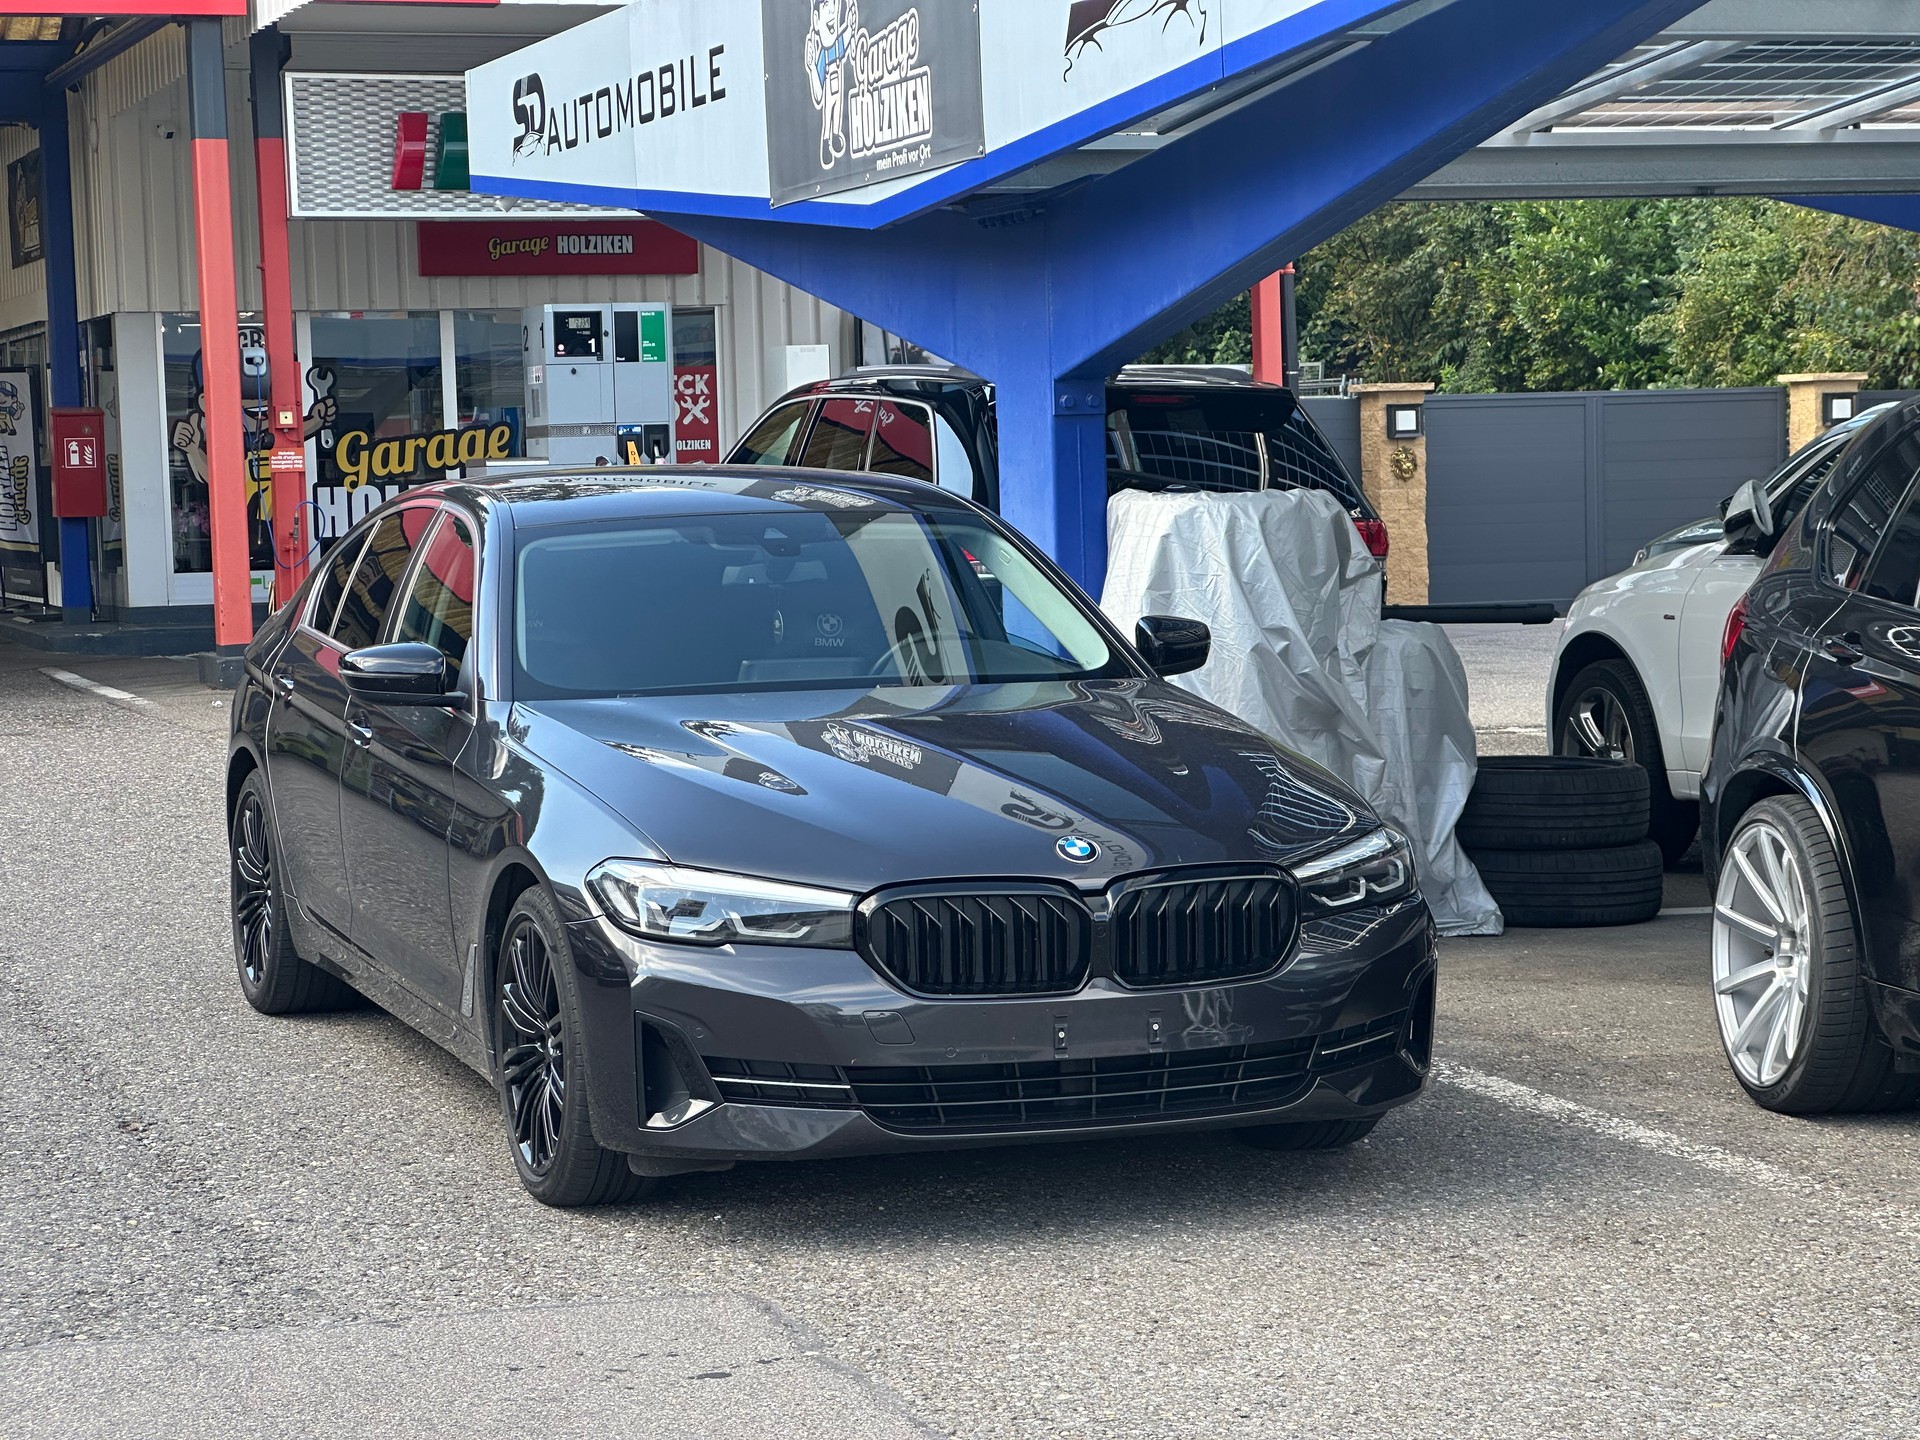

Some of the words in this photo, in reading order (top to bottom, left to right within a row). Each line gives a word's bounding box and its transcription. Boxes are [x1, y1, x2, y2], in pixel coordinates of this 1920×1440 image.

[855, 14, 917, 96] Garage
[547, 44, 726, 156] AUTOMOBILE
[850, 74, 930, 151] HOLZIKEN
[876, 154, 892, 171] mein
[892, 148, 908, 167] Profi
[908, 151, 919, 163] vor
[919, 144, 931, 160] Ort
[488, 236, 549, 260] Garage
[556, 235, 633, 254] HOLZIKEN
[523, 325, 529, 352] 2
[539, 322, 545, 349] 1
[588, 338, 596, 353] 1
[676, 439, 711, 451] OLZIKEN
[336, 425, 511, 493] Garage
[814, 637, 845, 647] BMW
